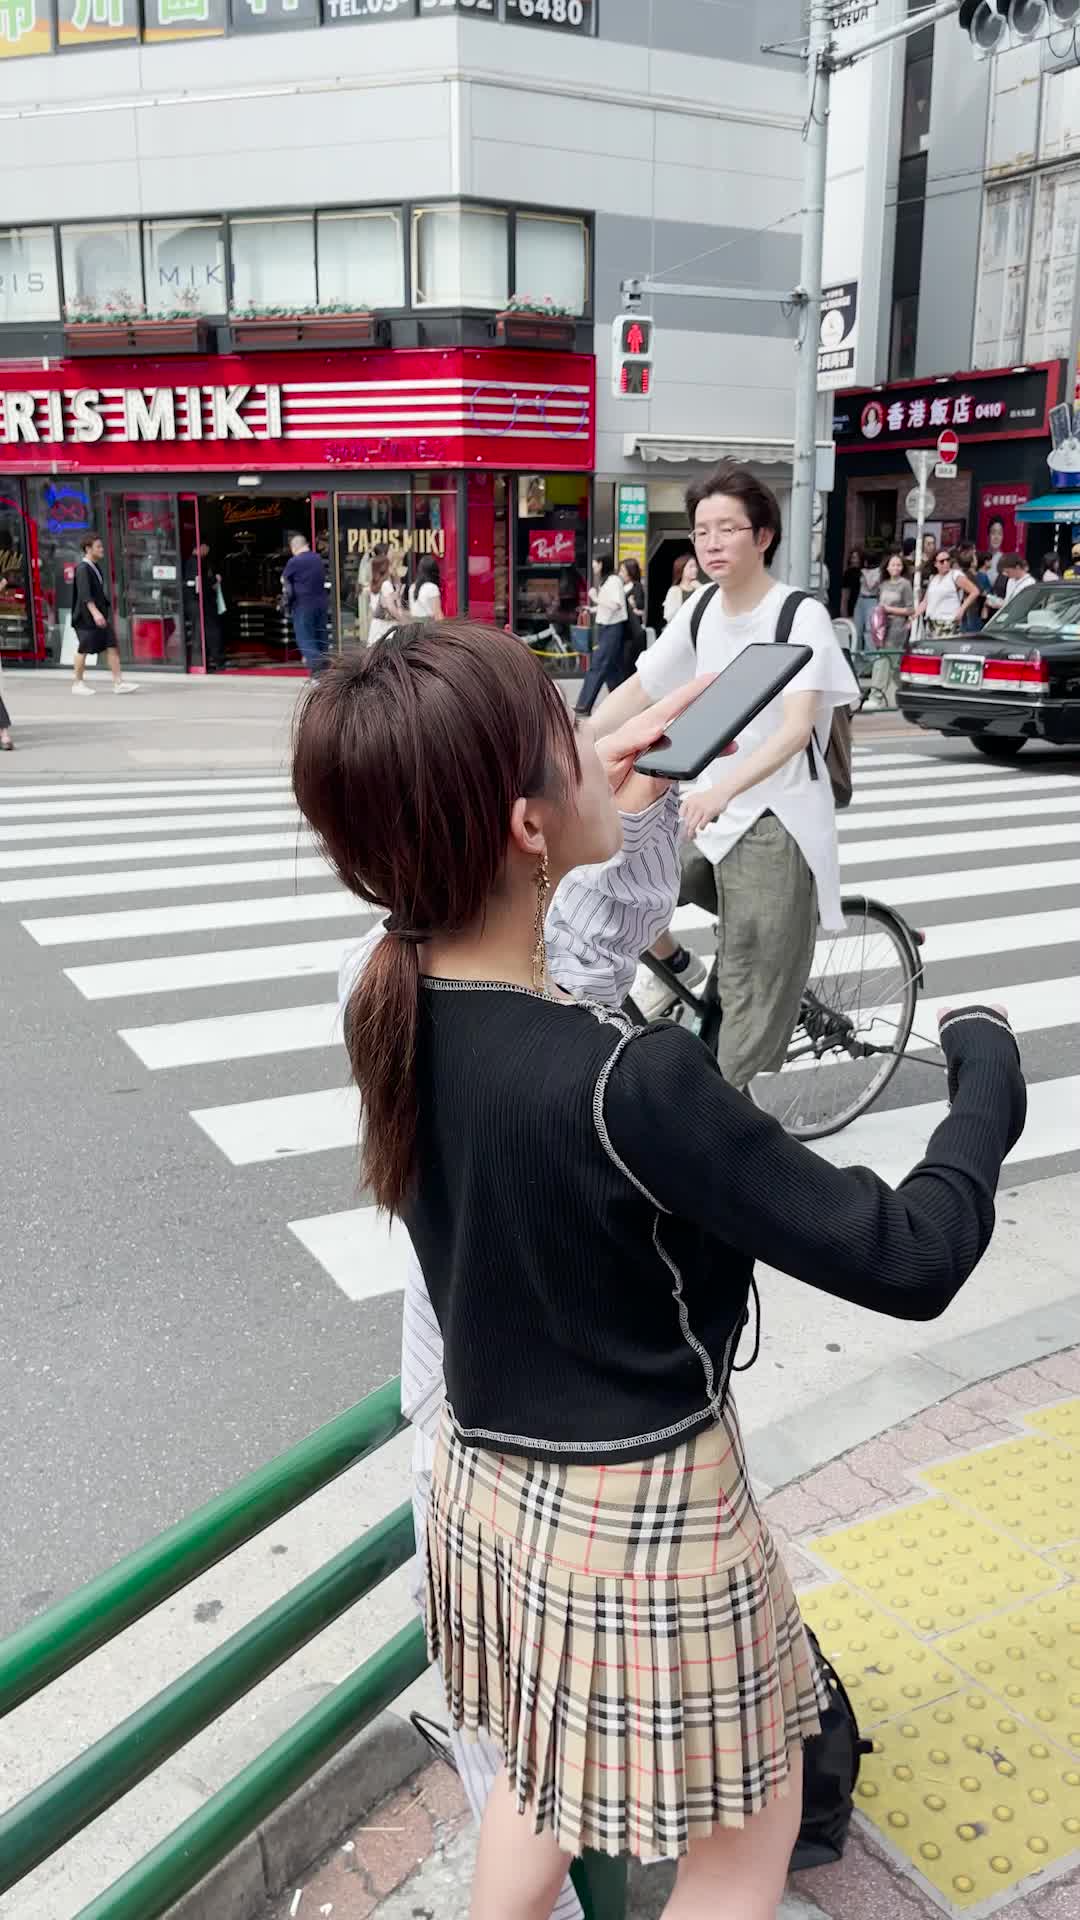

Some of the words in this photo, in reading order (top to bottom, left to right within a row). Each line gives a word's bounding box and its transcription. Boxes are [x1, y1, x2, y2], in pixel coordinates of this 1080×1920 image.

[159, 263, 235, 286] MIKI
[124, 383, 282, 441] MIKI
[886, 395, 971, 431] 香港飯店
[975, 402, 1003, 419] 0410
[347, 529, 400, 553] PARIS
[402, 528, 445, 553] MIKI
